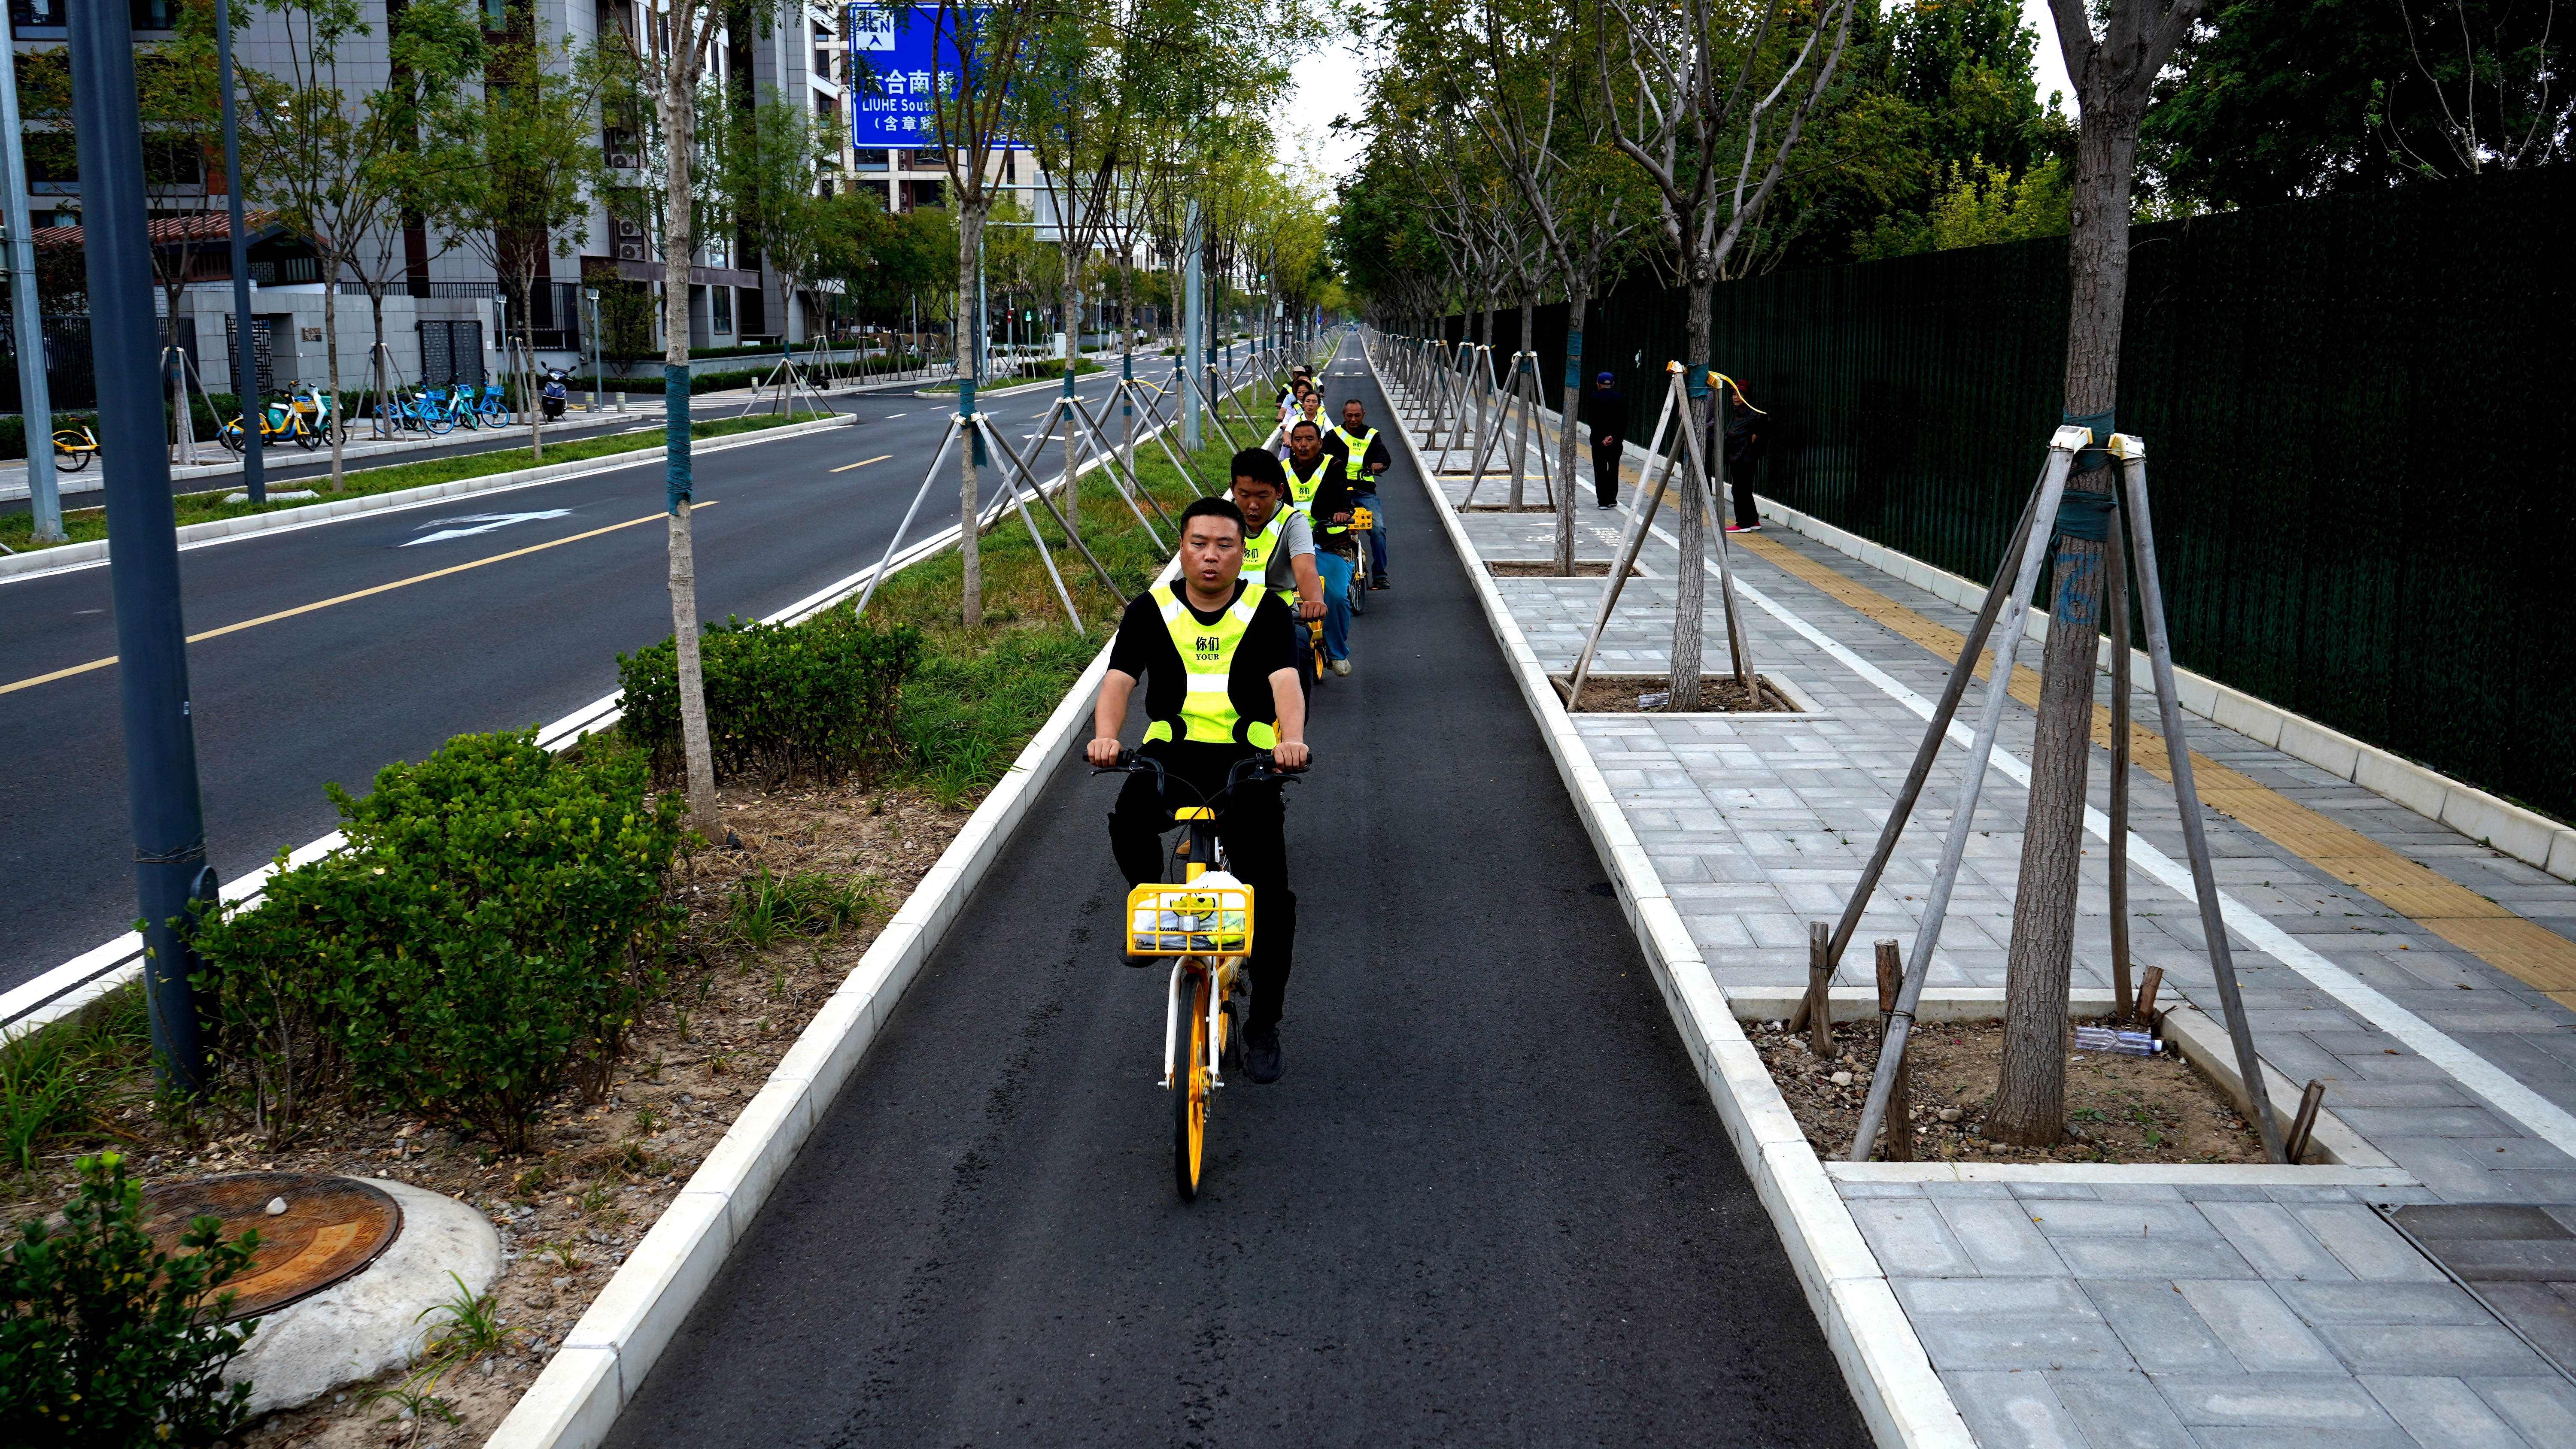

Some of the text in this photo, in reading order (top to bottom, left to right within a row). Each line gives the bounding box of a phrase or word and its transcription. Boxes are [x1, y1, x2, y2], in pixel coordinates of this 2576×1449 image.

[863, 99, 936, 112] LIUHE Sout
[1244, 548, 1258, 558] 你们
[1196, 637, 1219, 651] 你们
